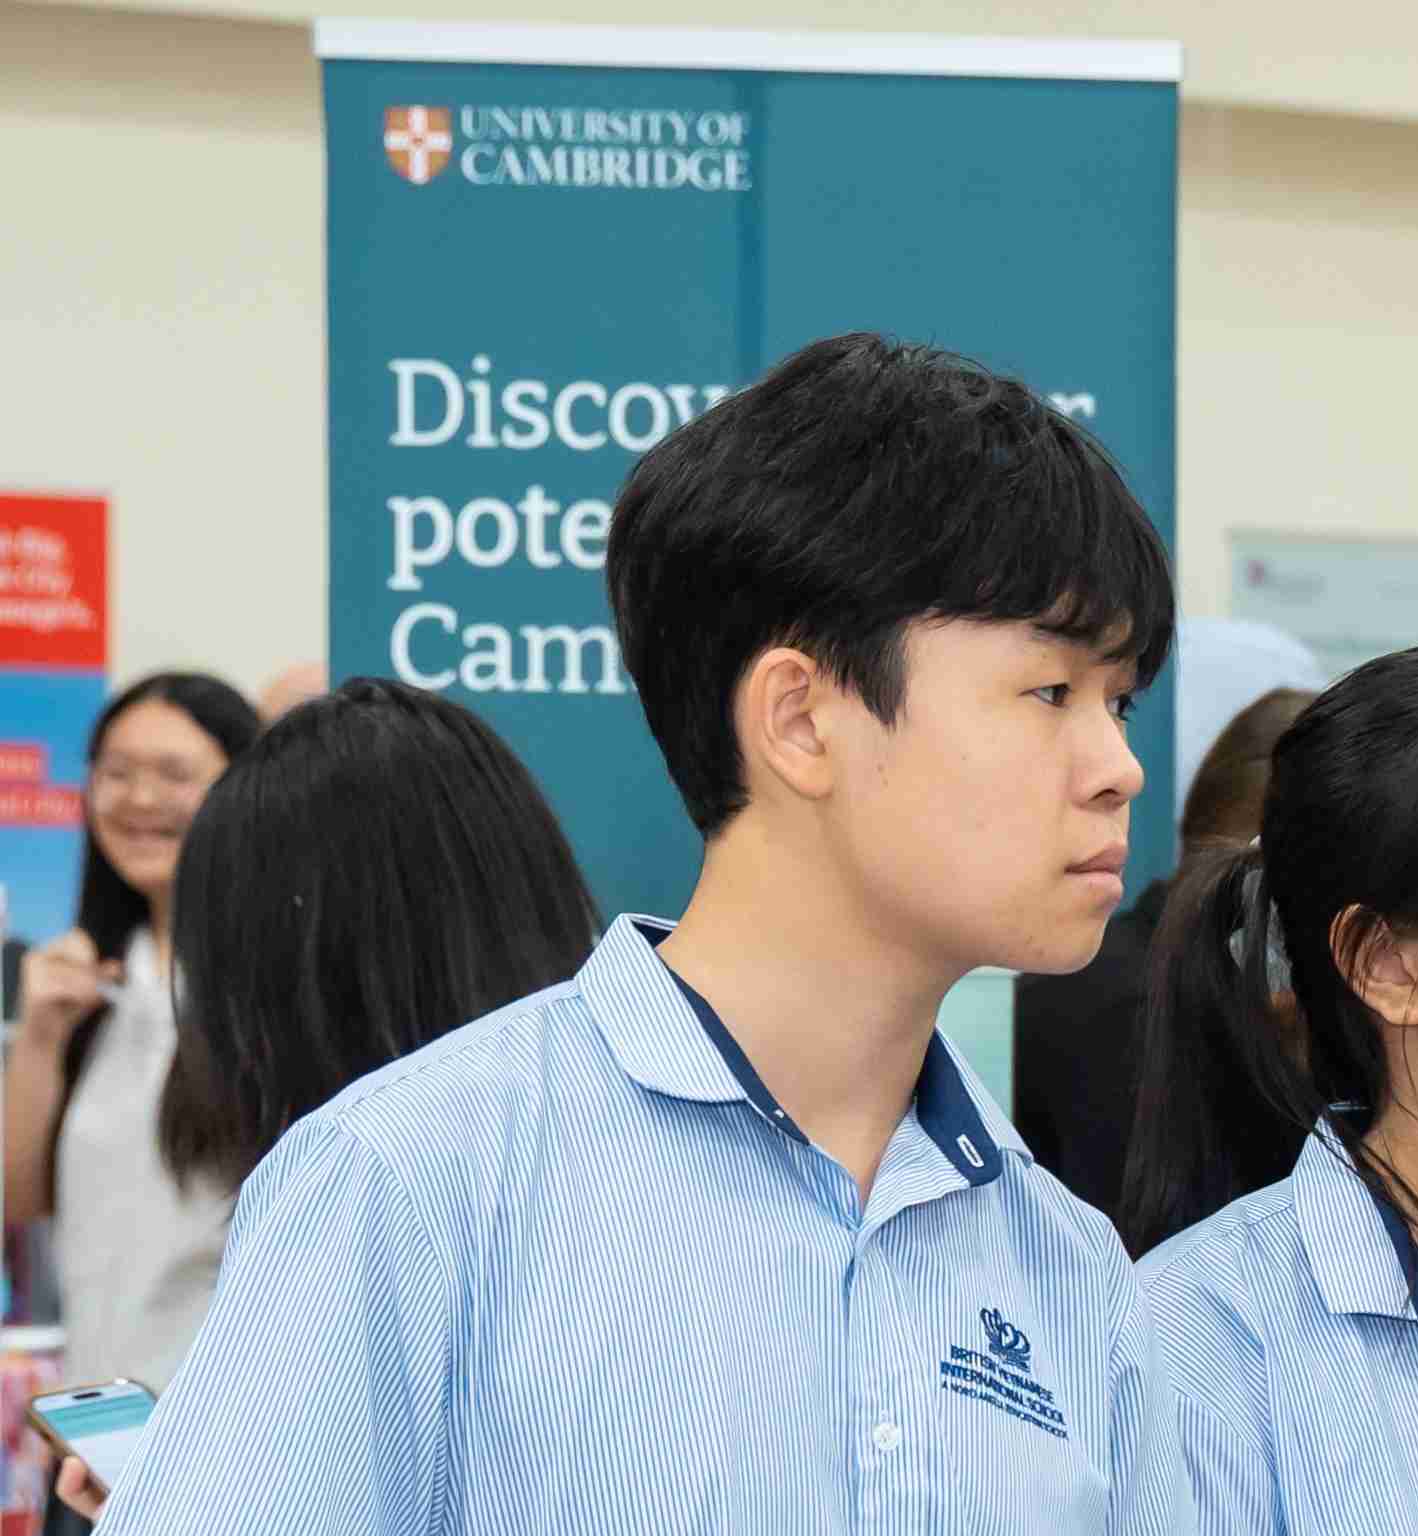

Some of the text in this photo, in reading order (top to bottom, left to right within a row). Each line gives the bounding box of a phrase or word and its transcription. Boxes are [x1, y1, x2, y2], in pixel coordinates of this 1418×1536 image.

[460, 104, 746, 147] UNIVERSITY OF
[460, 142, 753, 192] CAMBRIDGE
[387, 353, 736, 450] Discov
[386, 485, 612, 591] pote
[389, 602, 632, 695] Cam
